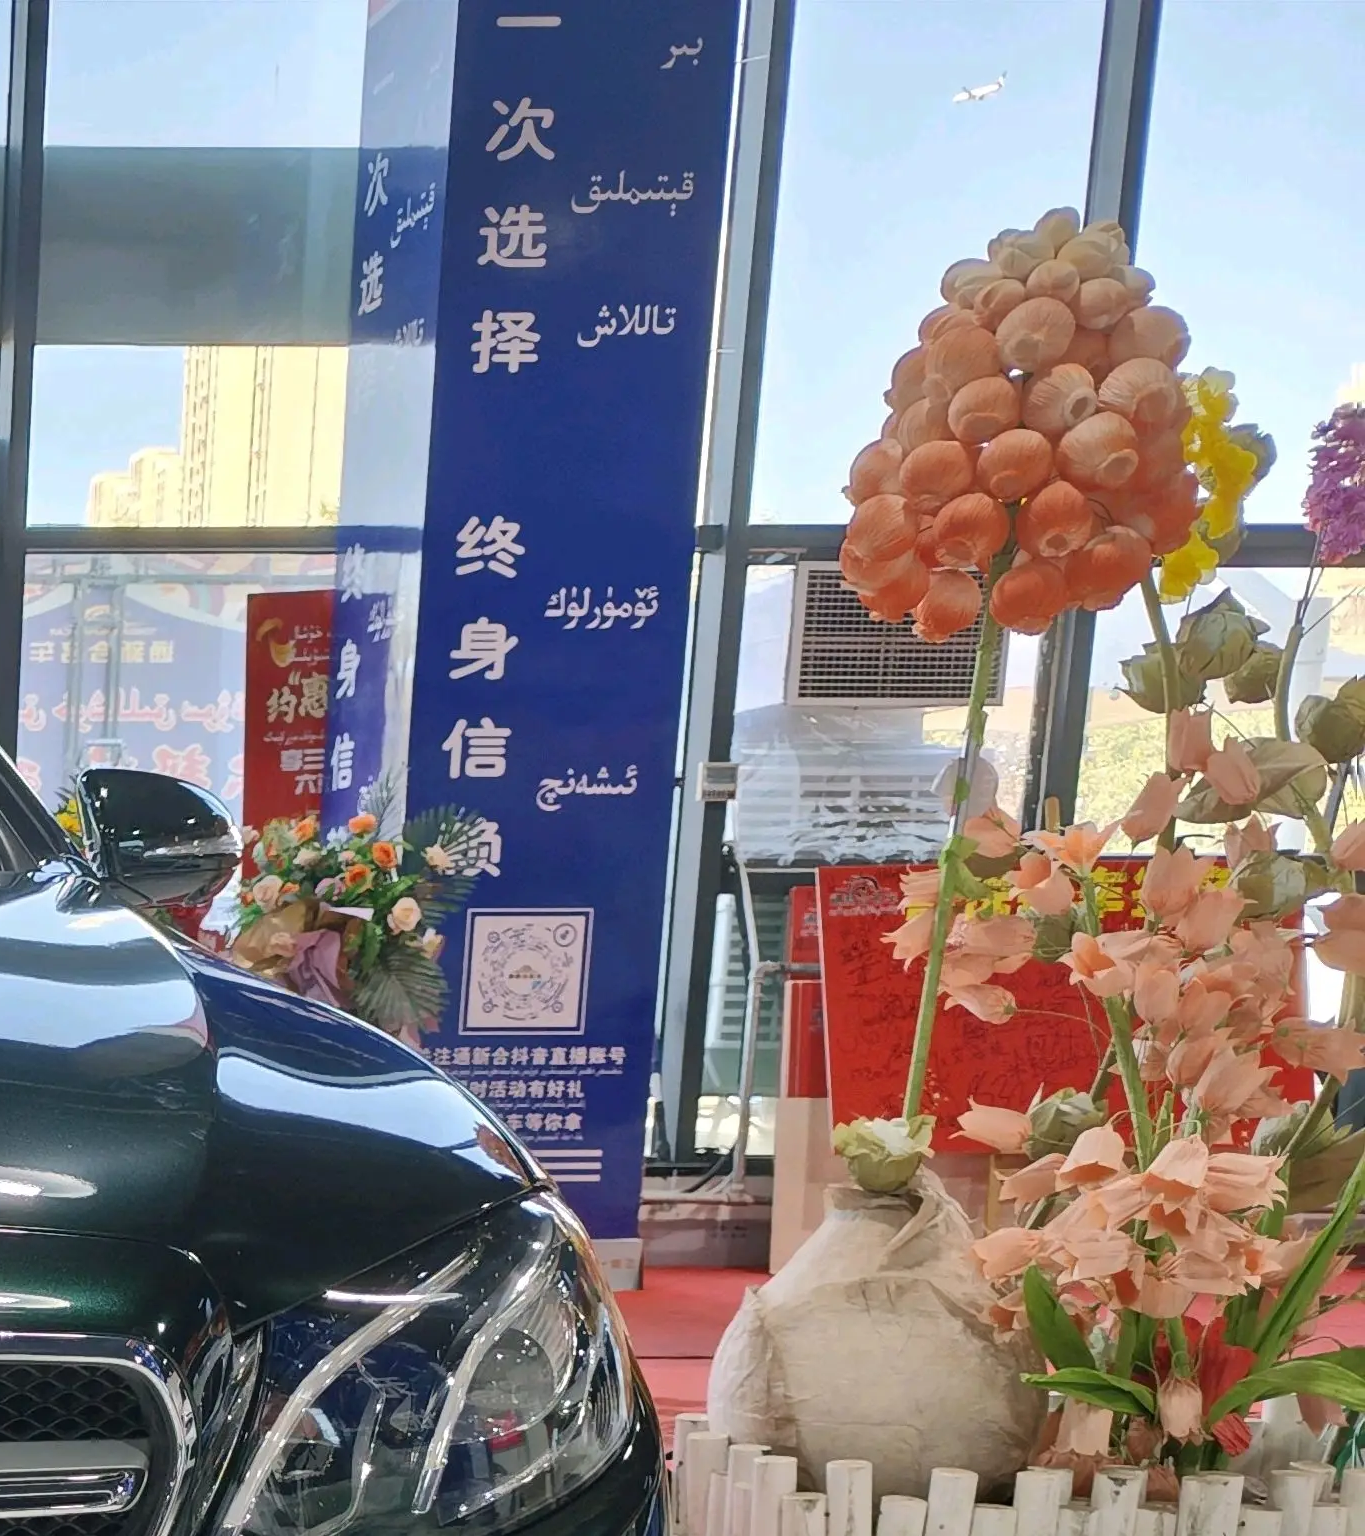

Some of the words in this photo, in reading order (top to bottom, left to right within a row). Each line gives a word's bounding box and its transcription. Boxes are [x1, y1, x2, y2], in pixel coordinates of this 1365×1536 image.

[661, 37, 703, 68] بىر
[471, 16, 561, 374] 一次选择
[571, 170, 694, 216] قېتىملىق
[577, 304, 676, 347] تاللاش
[544, 586, 660, 630] ئۆمۈرلۈك
